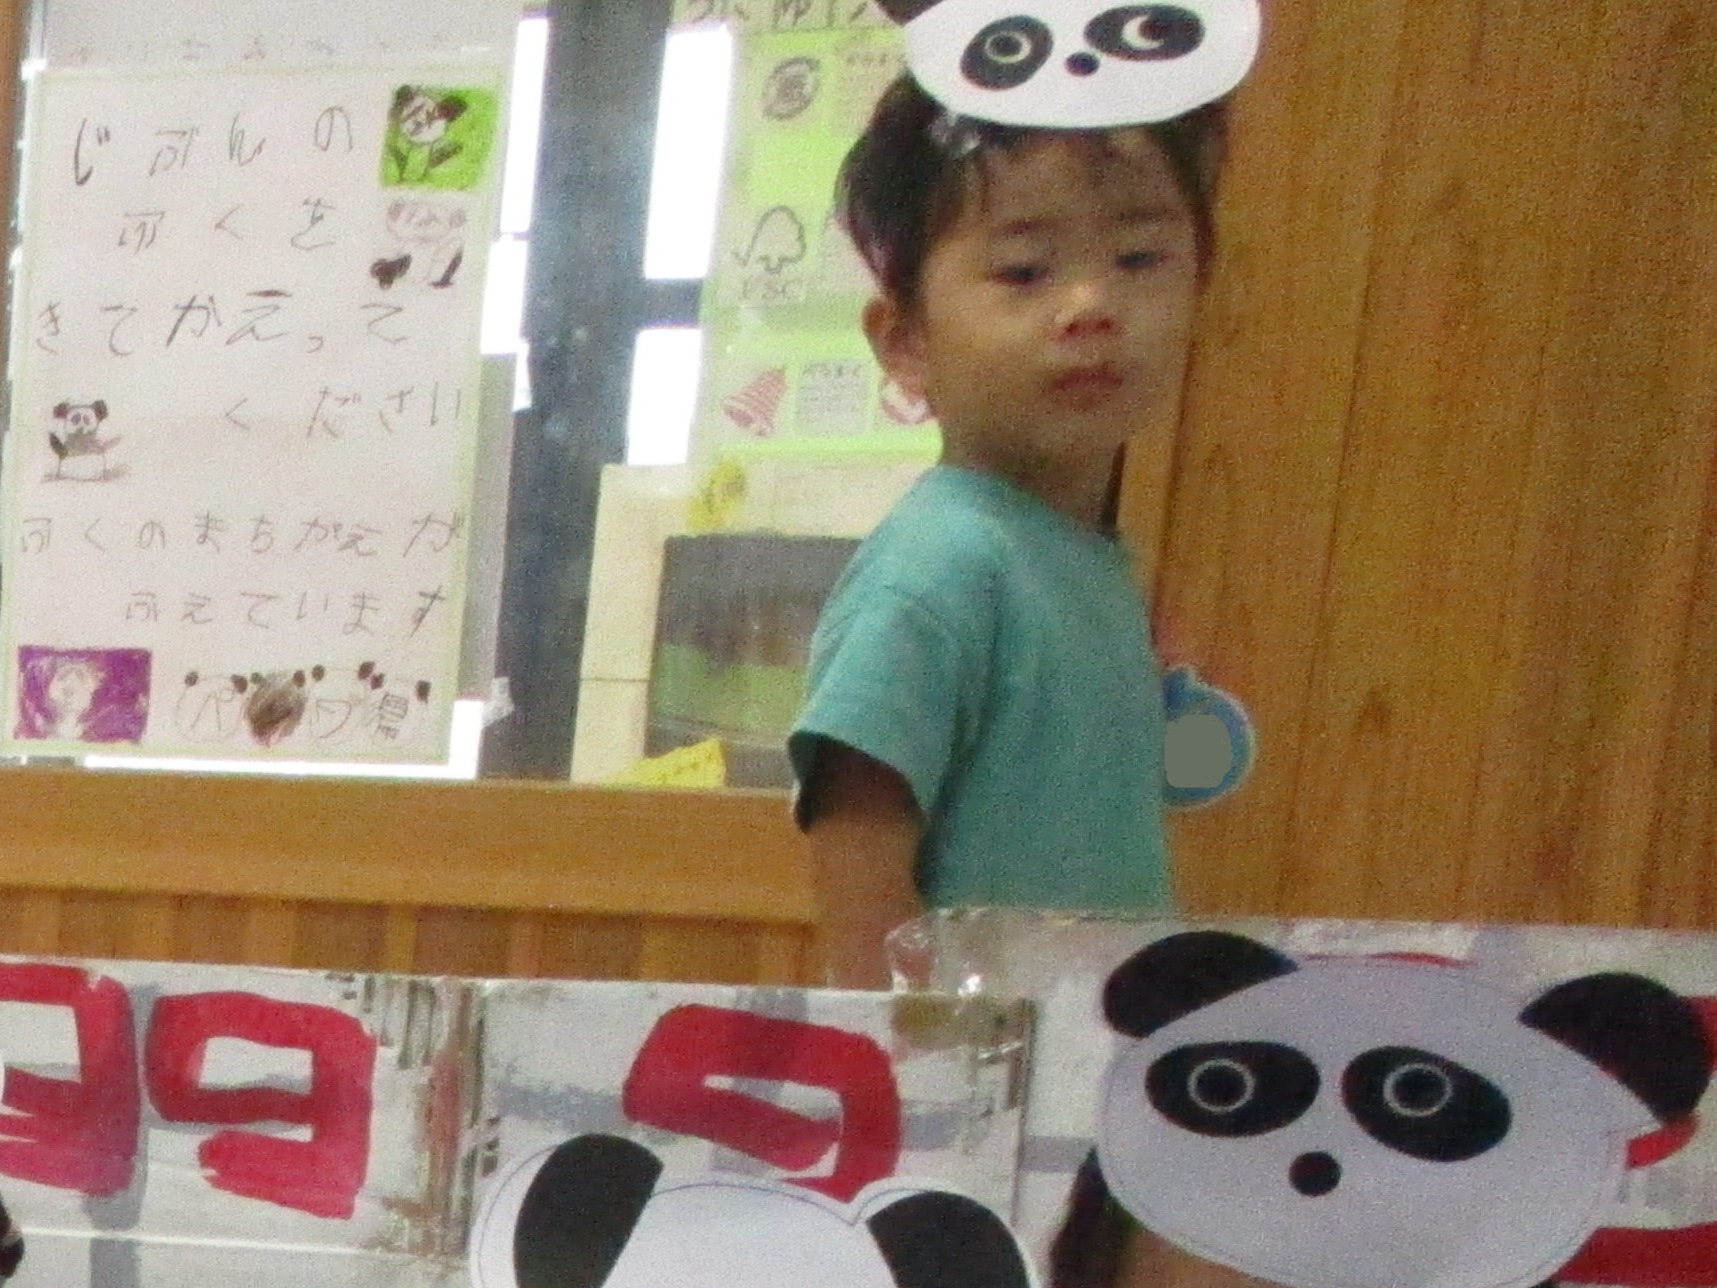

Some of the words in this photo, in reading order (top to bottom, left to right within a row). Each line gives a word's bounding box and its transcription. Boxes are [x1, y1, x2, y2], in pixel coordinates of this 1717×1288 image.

[74, 106, 355, 186] じぶんの
[117, 198, 336, 254] ふくを
[36, 290, 408, 357] きてかえって
[224, 380, 463, 439] ください
[125, 586, 447, 637] ふえています
